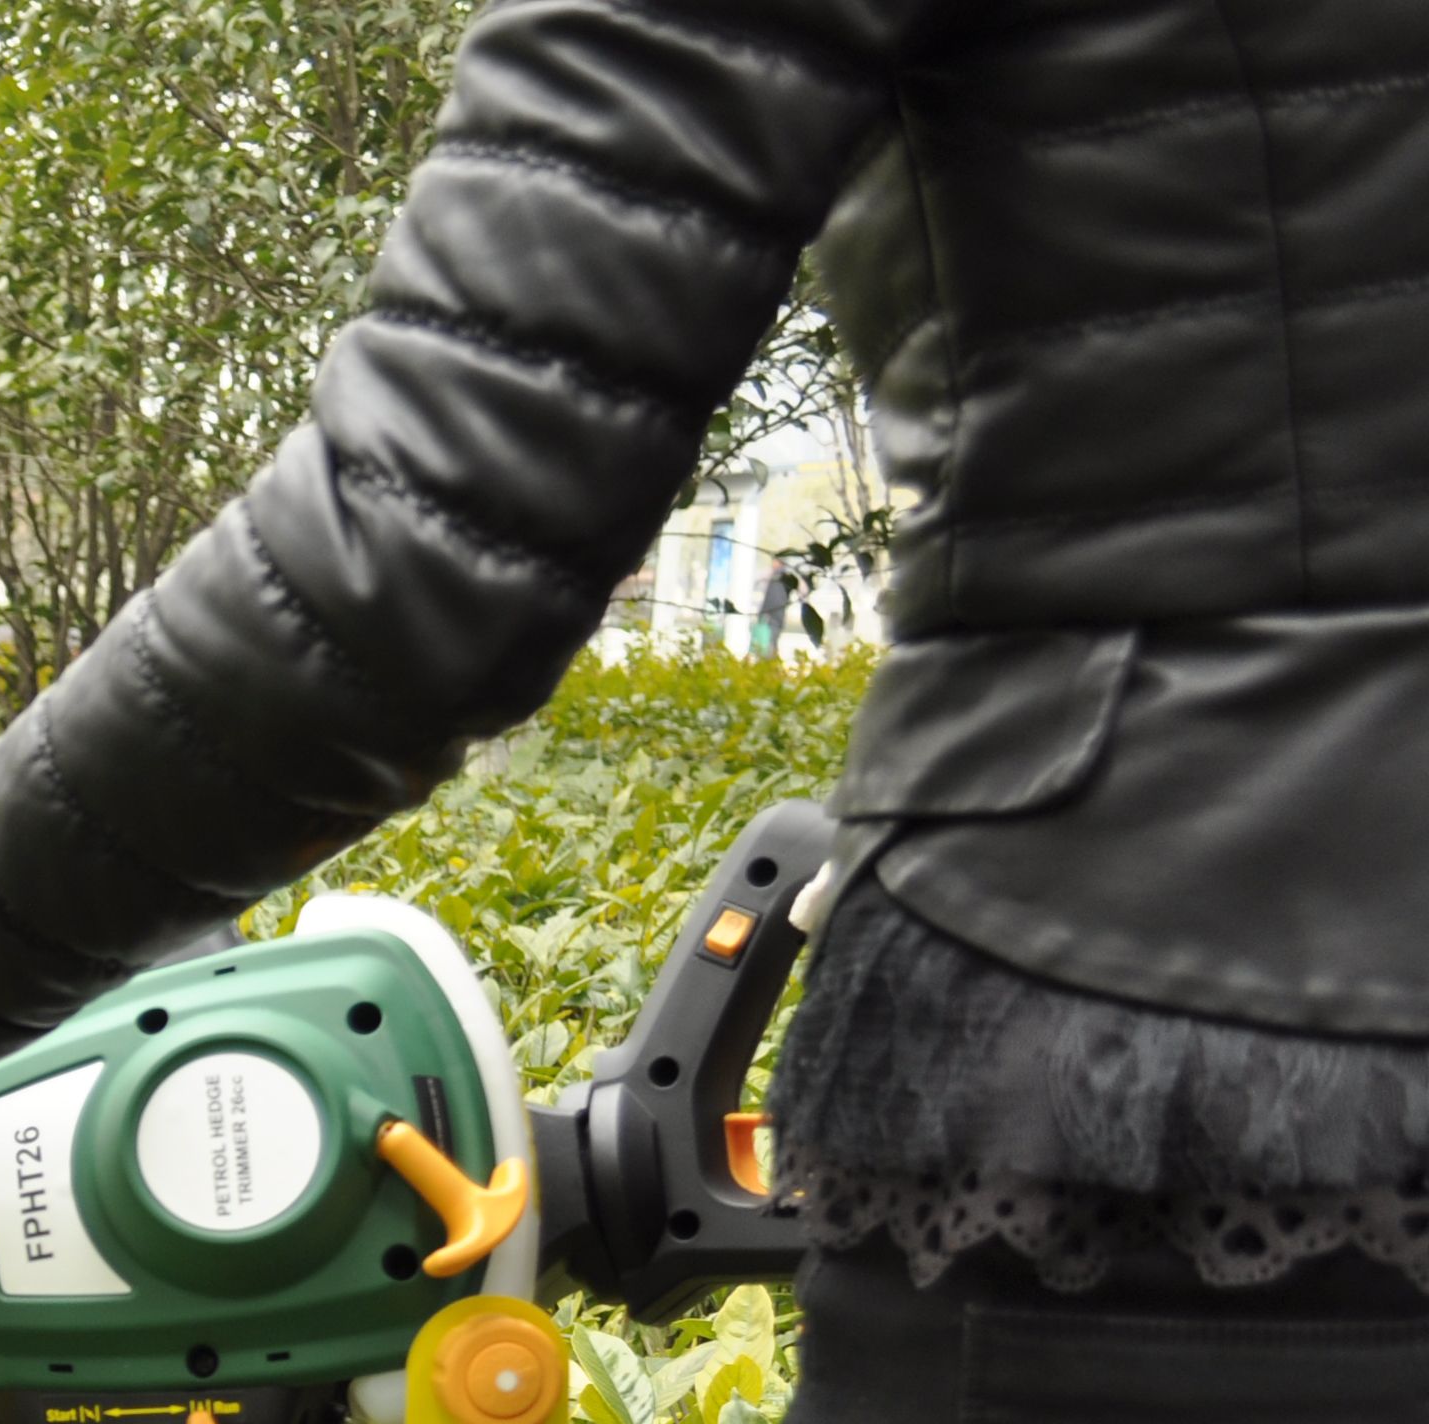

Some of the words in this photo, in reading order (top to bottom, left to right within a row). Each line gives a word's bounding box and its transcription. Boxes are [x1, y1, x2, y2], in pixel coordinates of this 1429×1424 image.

[205, 1074, 224, 1138] HEDGE
[231, 1075, 245, 1115] 26cc
[14, 1126, 54, 1263] FPHT26
[210, 1144, 231, 1218] PETROL
[233, 1121, 252, 1205] TRIMMER
[46, 1408, 77, 1423] Start
[213, 1401, 241, 1415] Run
